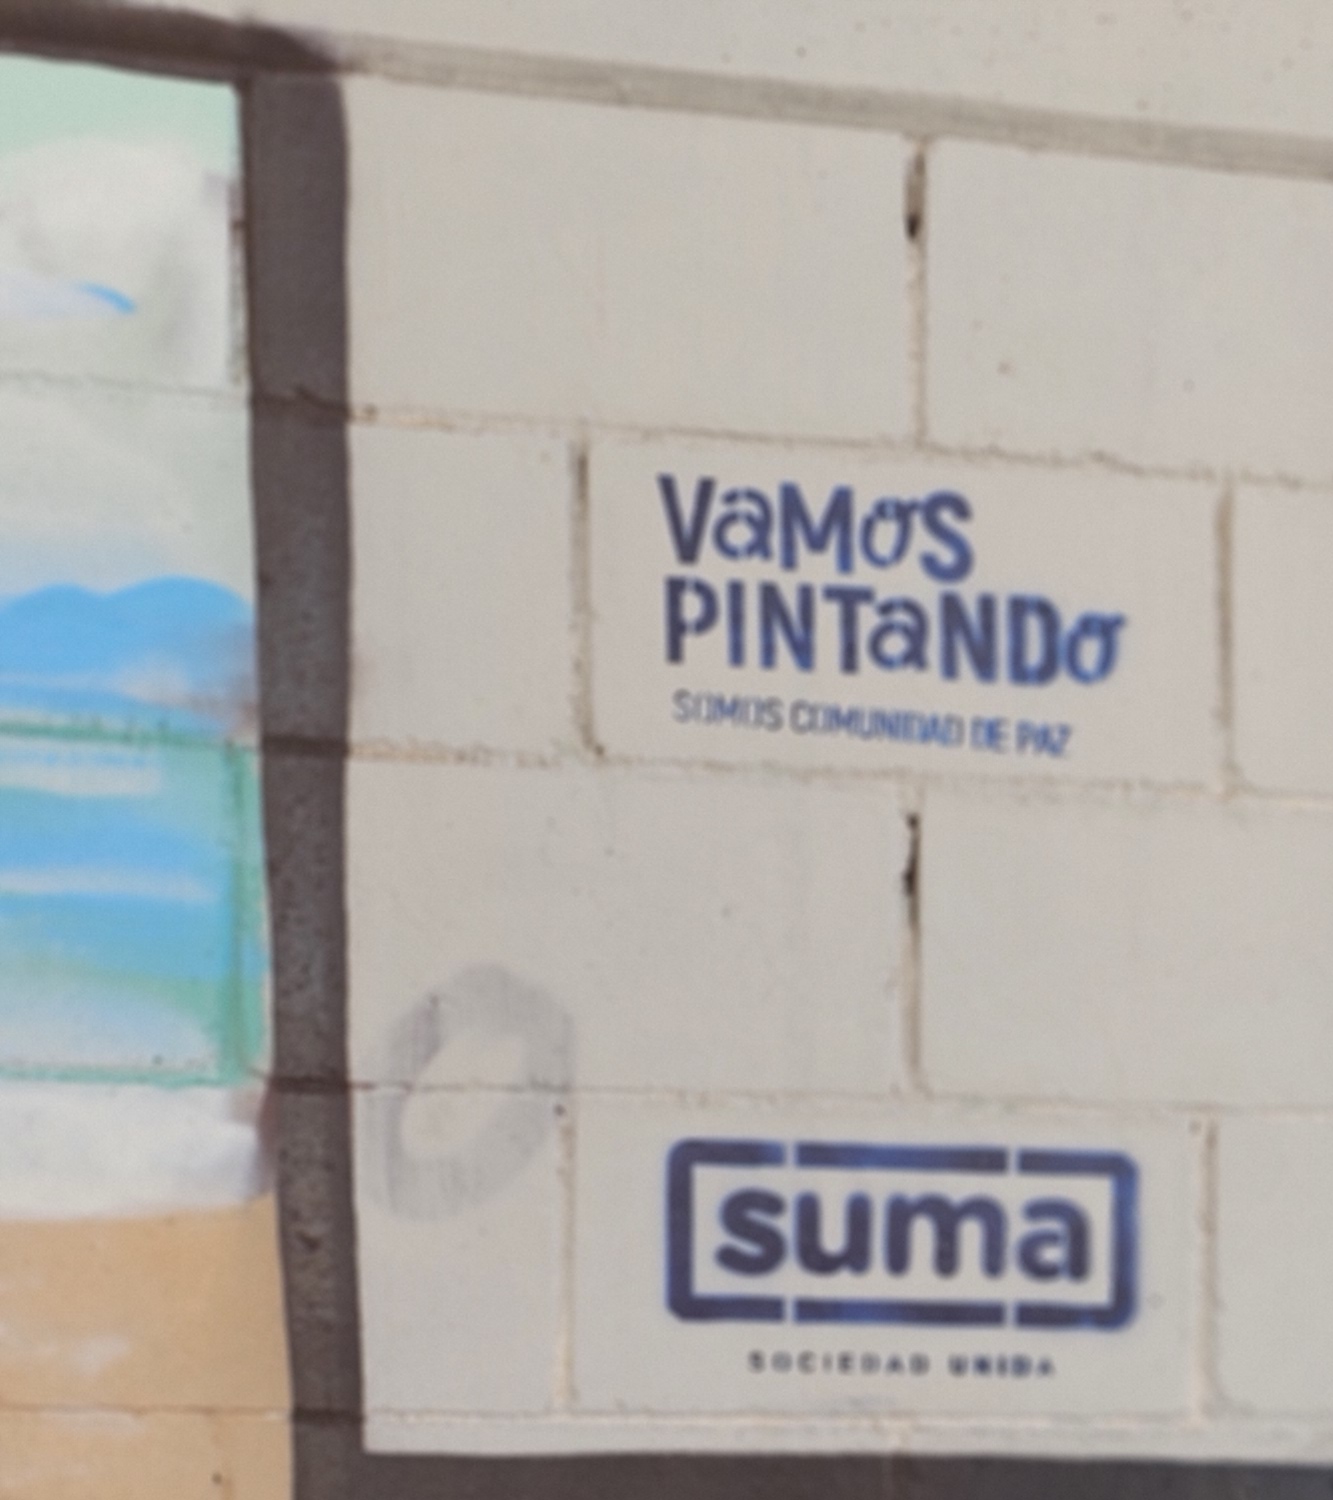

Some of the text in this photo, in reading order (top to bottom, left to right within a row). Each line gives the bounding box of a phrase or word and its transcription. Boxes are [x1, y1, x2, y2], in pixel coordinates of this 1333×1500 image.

[672, 687, 1072, 757] SOMOS COMUNIDAD DE PAZ
[714, 1188, 1092, 1283] suma
[748, 1349, 1055, 1379] SOCIEDAD UNIDA
